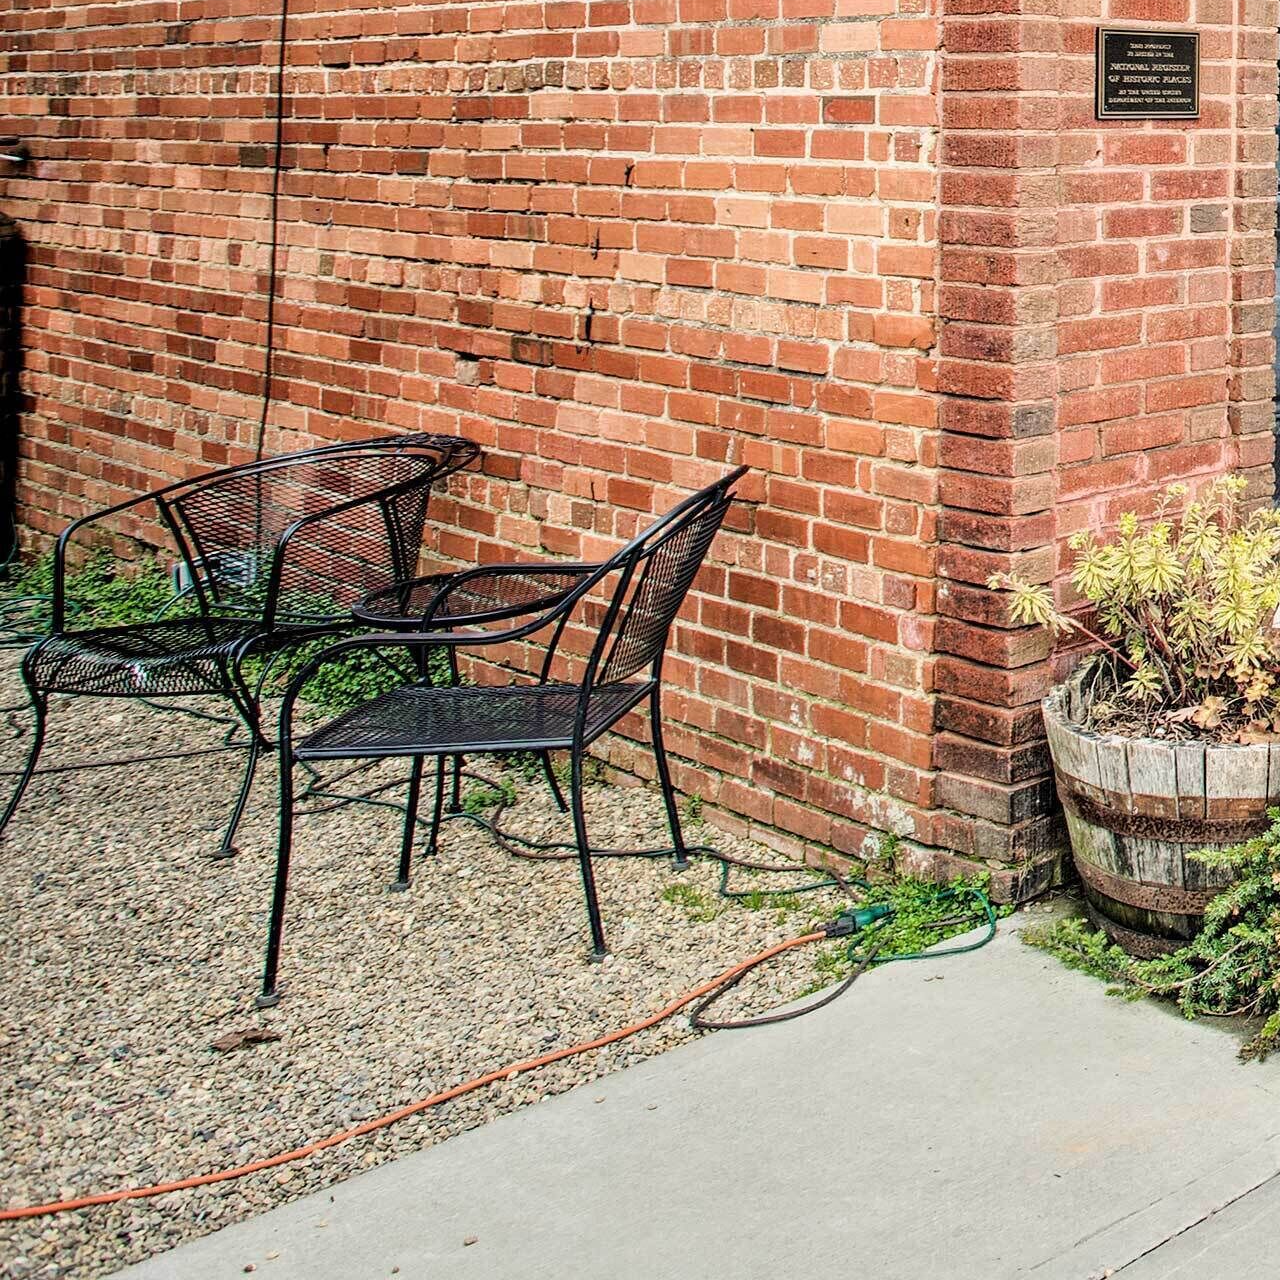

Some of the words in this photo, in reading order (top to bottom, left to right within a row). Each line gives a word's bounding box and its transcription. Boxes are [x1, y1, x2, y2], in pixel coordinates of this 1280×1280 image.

[1110, 63, 1150, 72] NATIONAL
[1152, 64, 1191, 72] REGISTER
[1108, 75, 1120, 83] OF
[1122, 75, 1161, 83] HISTORIC
[1162, 76, 1193, 84] PLACES
